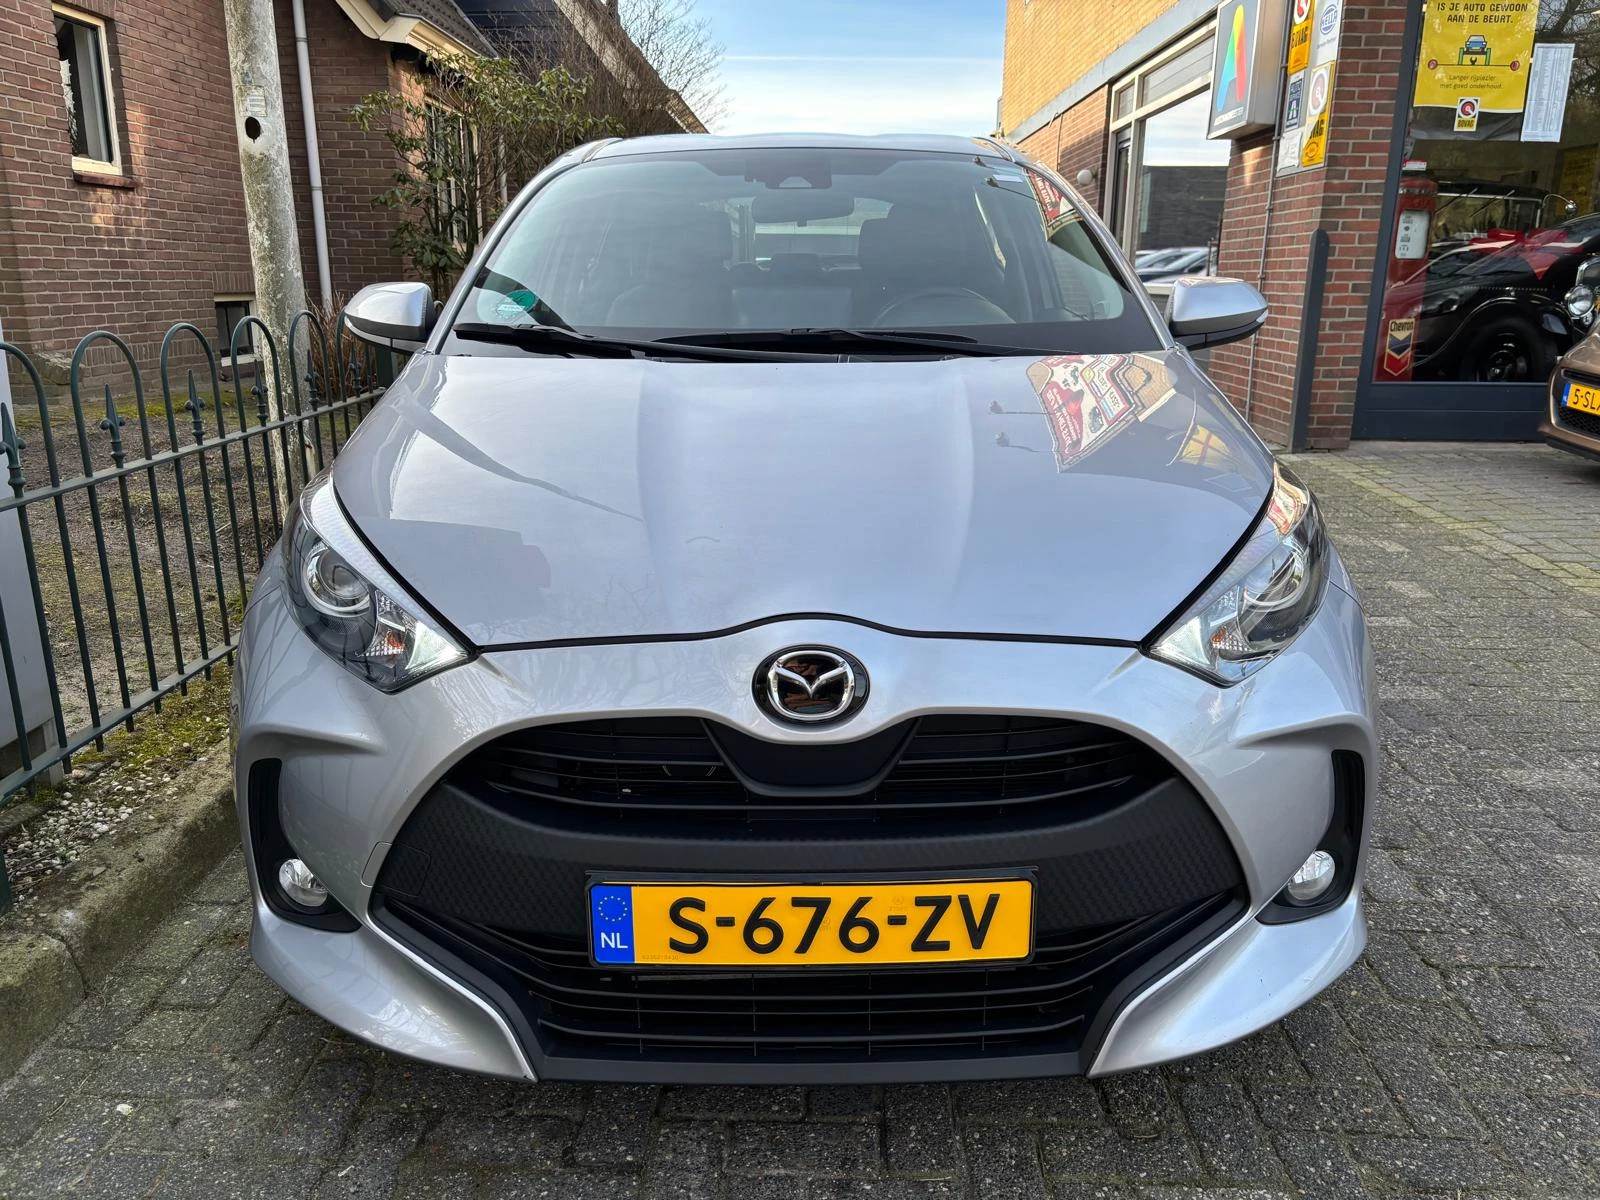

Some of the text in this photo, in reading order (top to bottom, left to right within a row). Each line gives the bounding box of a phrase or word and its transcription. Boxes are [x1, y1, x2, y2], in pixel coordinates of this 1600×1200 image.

[1437, 3, 1529, 12] IS JE AUTO GEWOON
[1447, 14, 1514, 24] AAN DE BEURT.
[1390, 321, 1413, 331] Chevron
[1573, 389, 1600, 411] 5-SL
[669, 893, 1000, 955] S-676-ZV
[600, 932, 629, 949] NL
